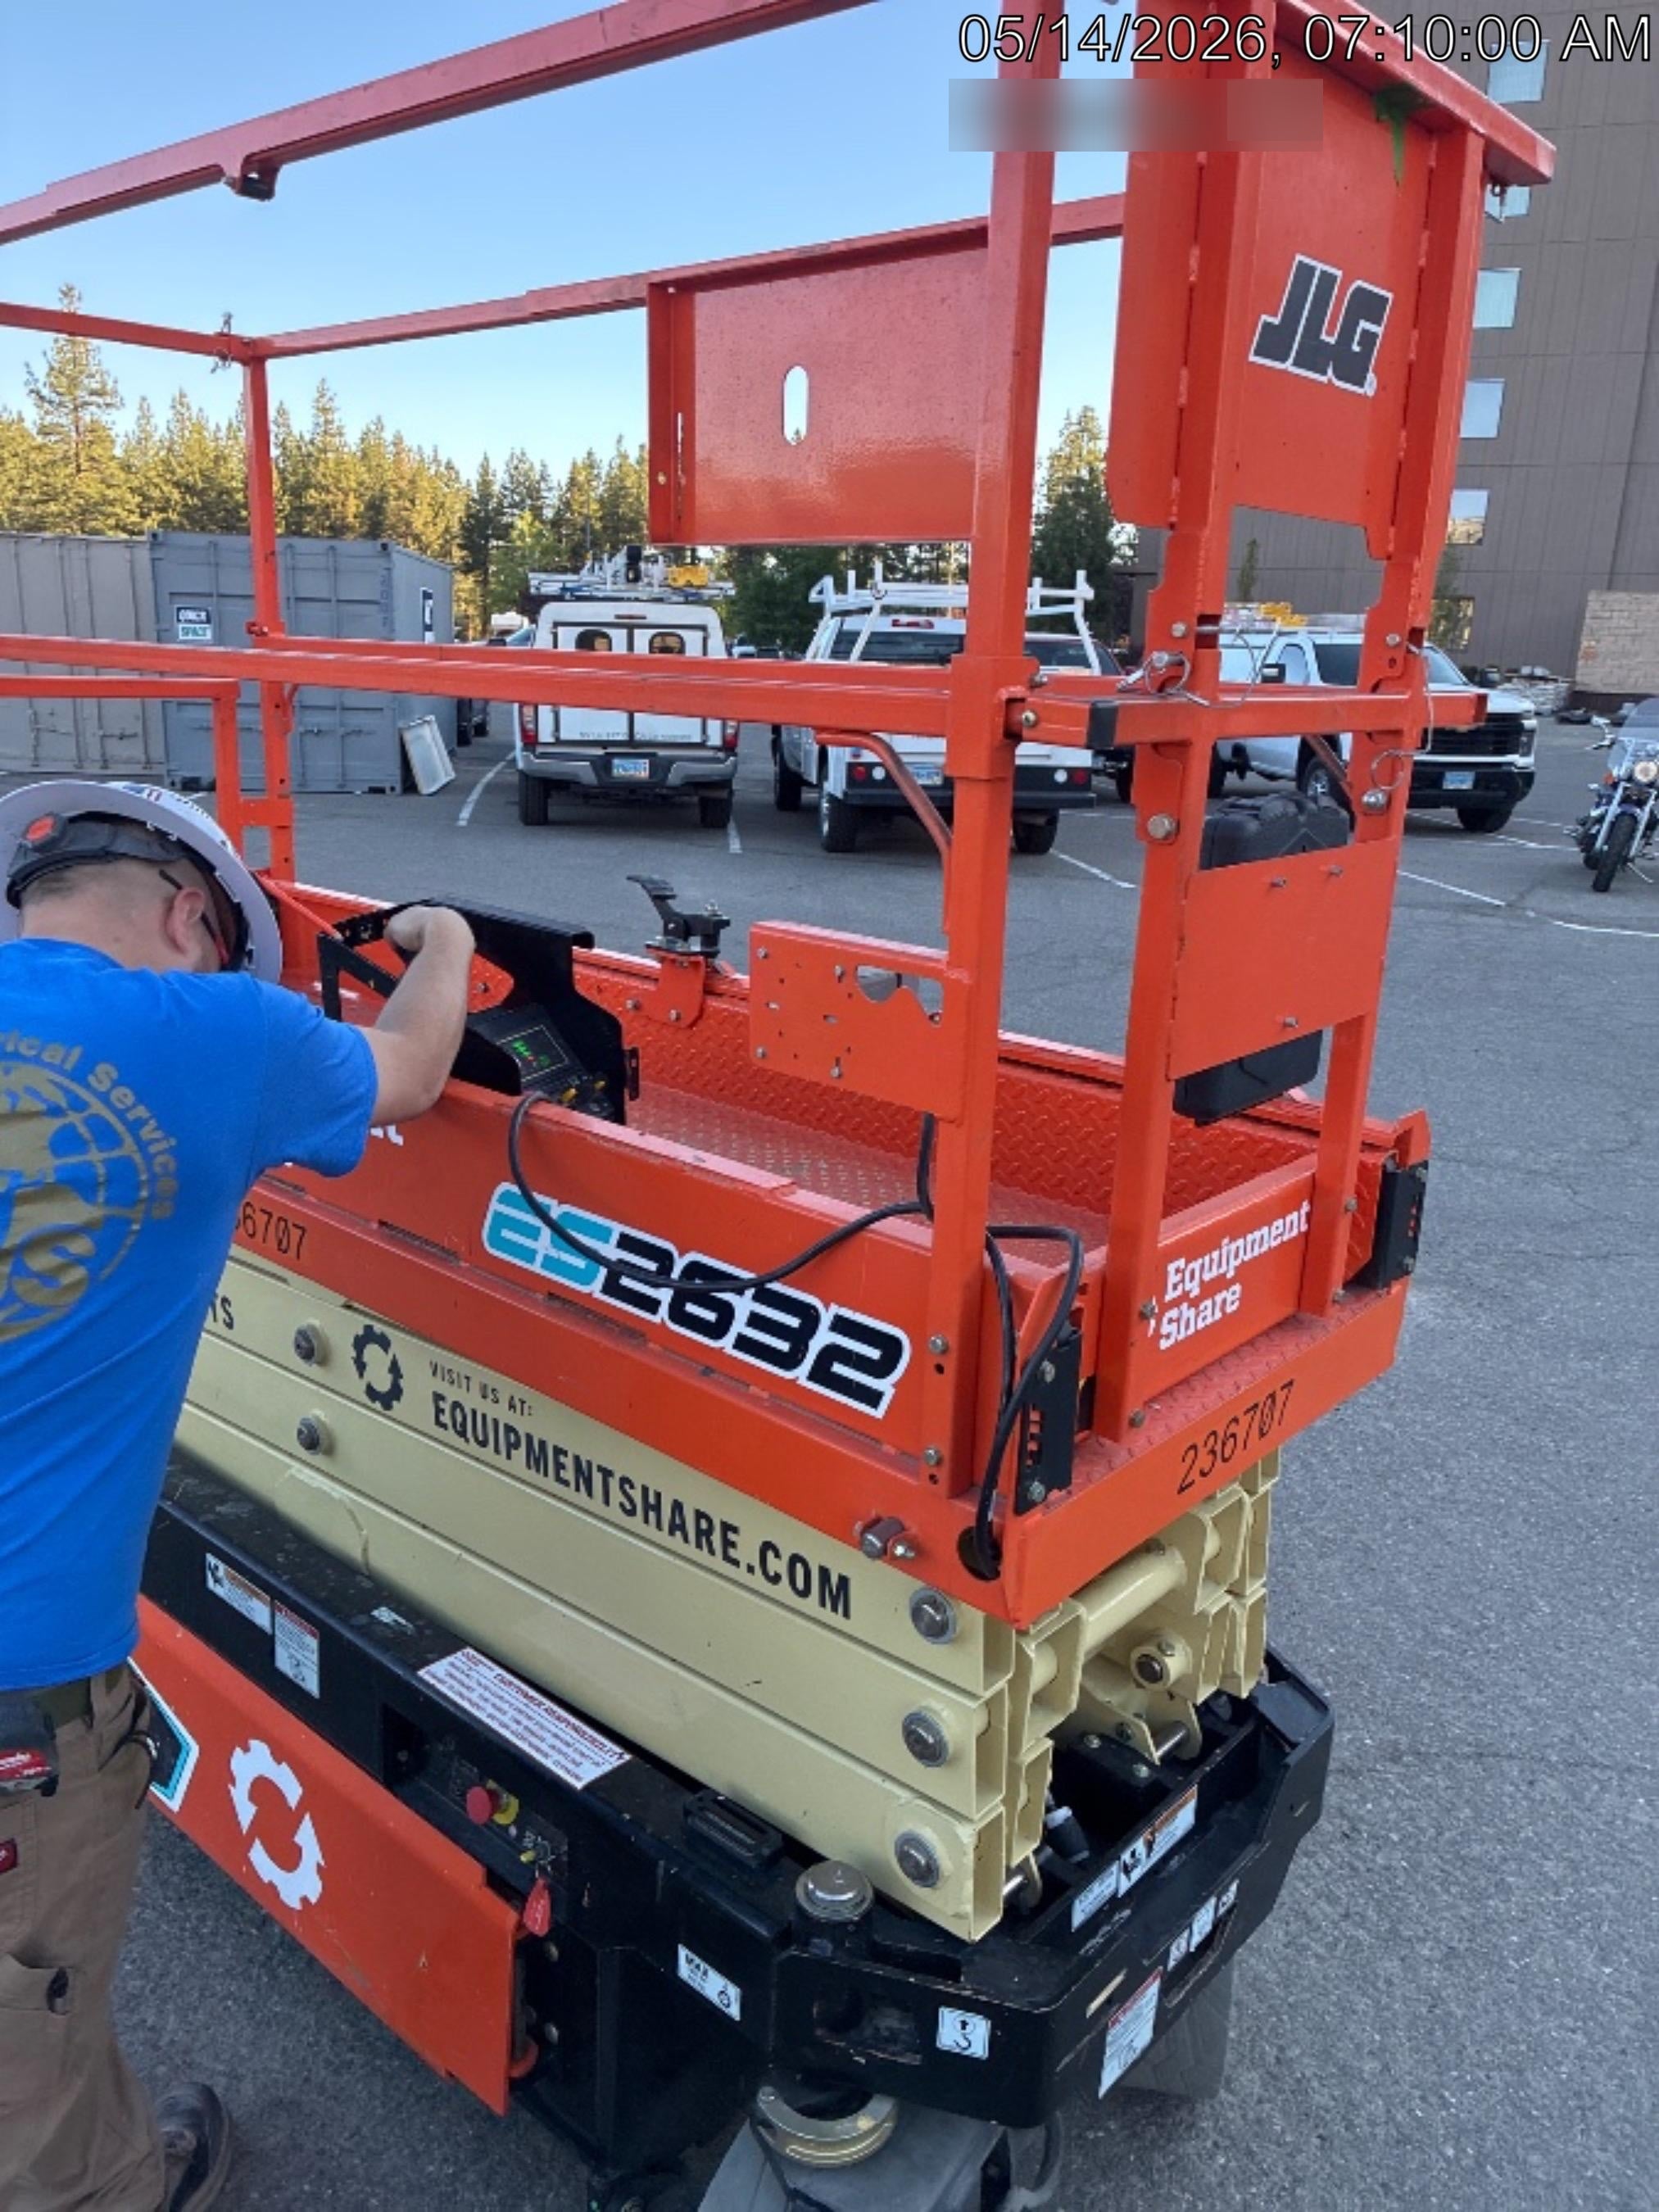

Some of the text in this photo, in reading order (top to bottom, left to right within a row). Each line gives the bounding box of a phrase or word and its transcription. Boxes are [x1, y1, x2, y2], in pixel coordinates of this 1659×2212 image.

[1249, 253, 1394, 398] JLG
[87, 1062, 178, 1219] Services
[483, 1183, 911, 1418] ES2632
[1158, 1281, 1243, 1351] Share
[1164, 1199, 1311, 1304] Equipment
[429, 1359, 533, 1416] VISIT US AT:
[1176, 1378, 1295, 1496] 236707
[432, 1390, 851, 1620] EQUIPMENTSHARE.COM
